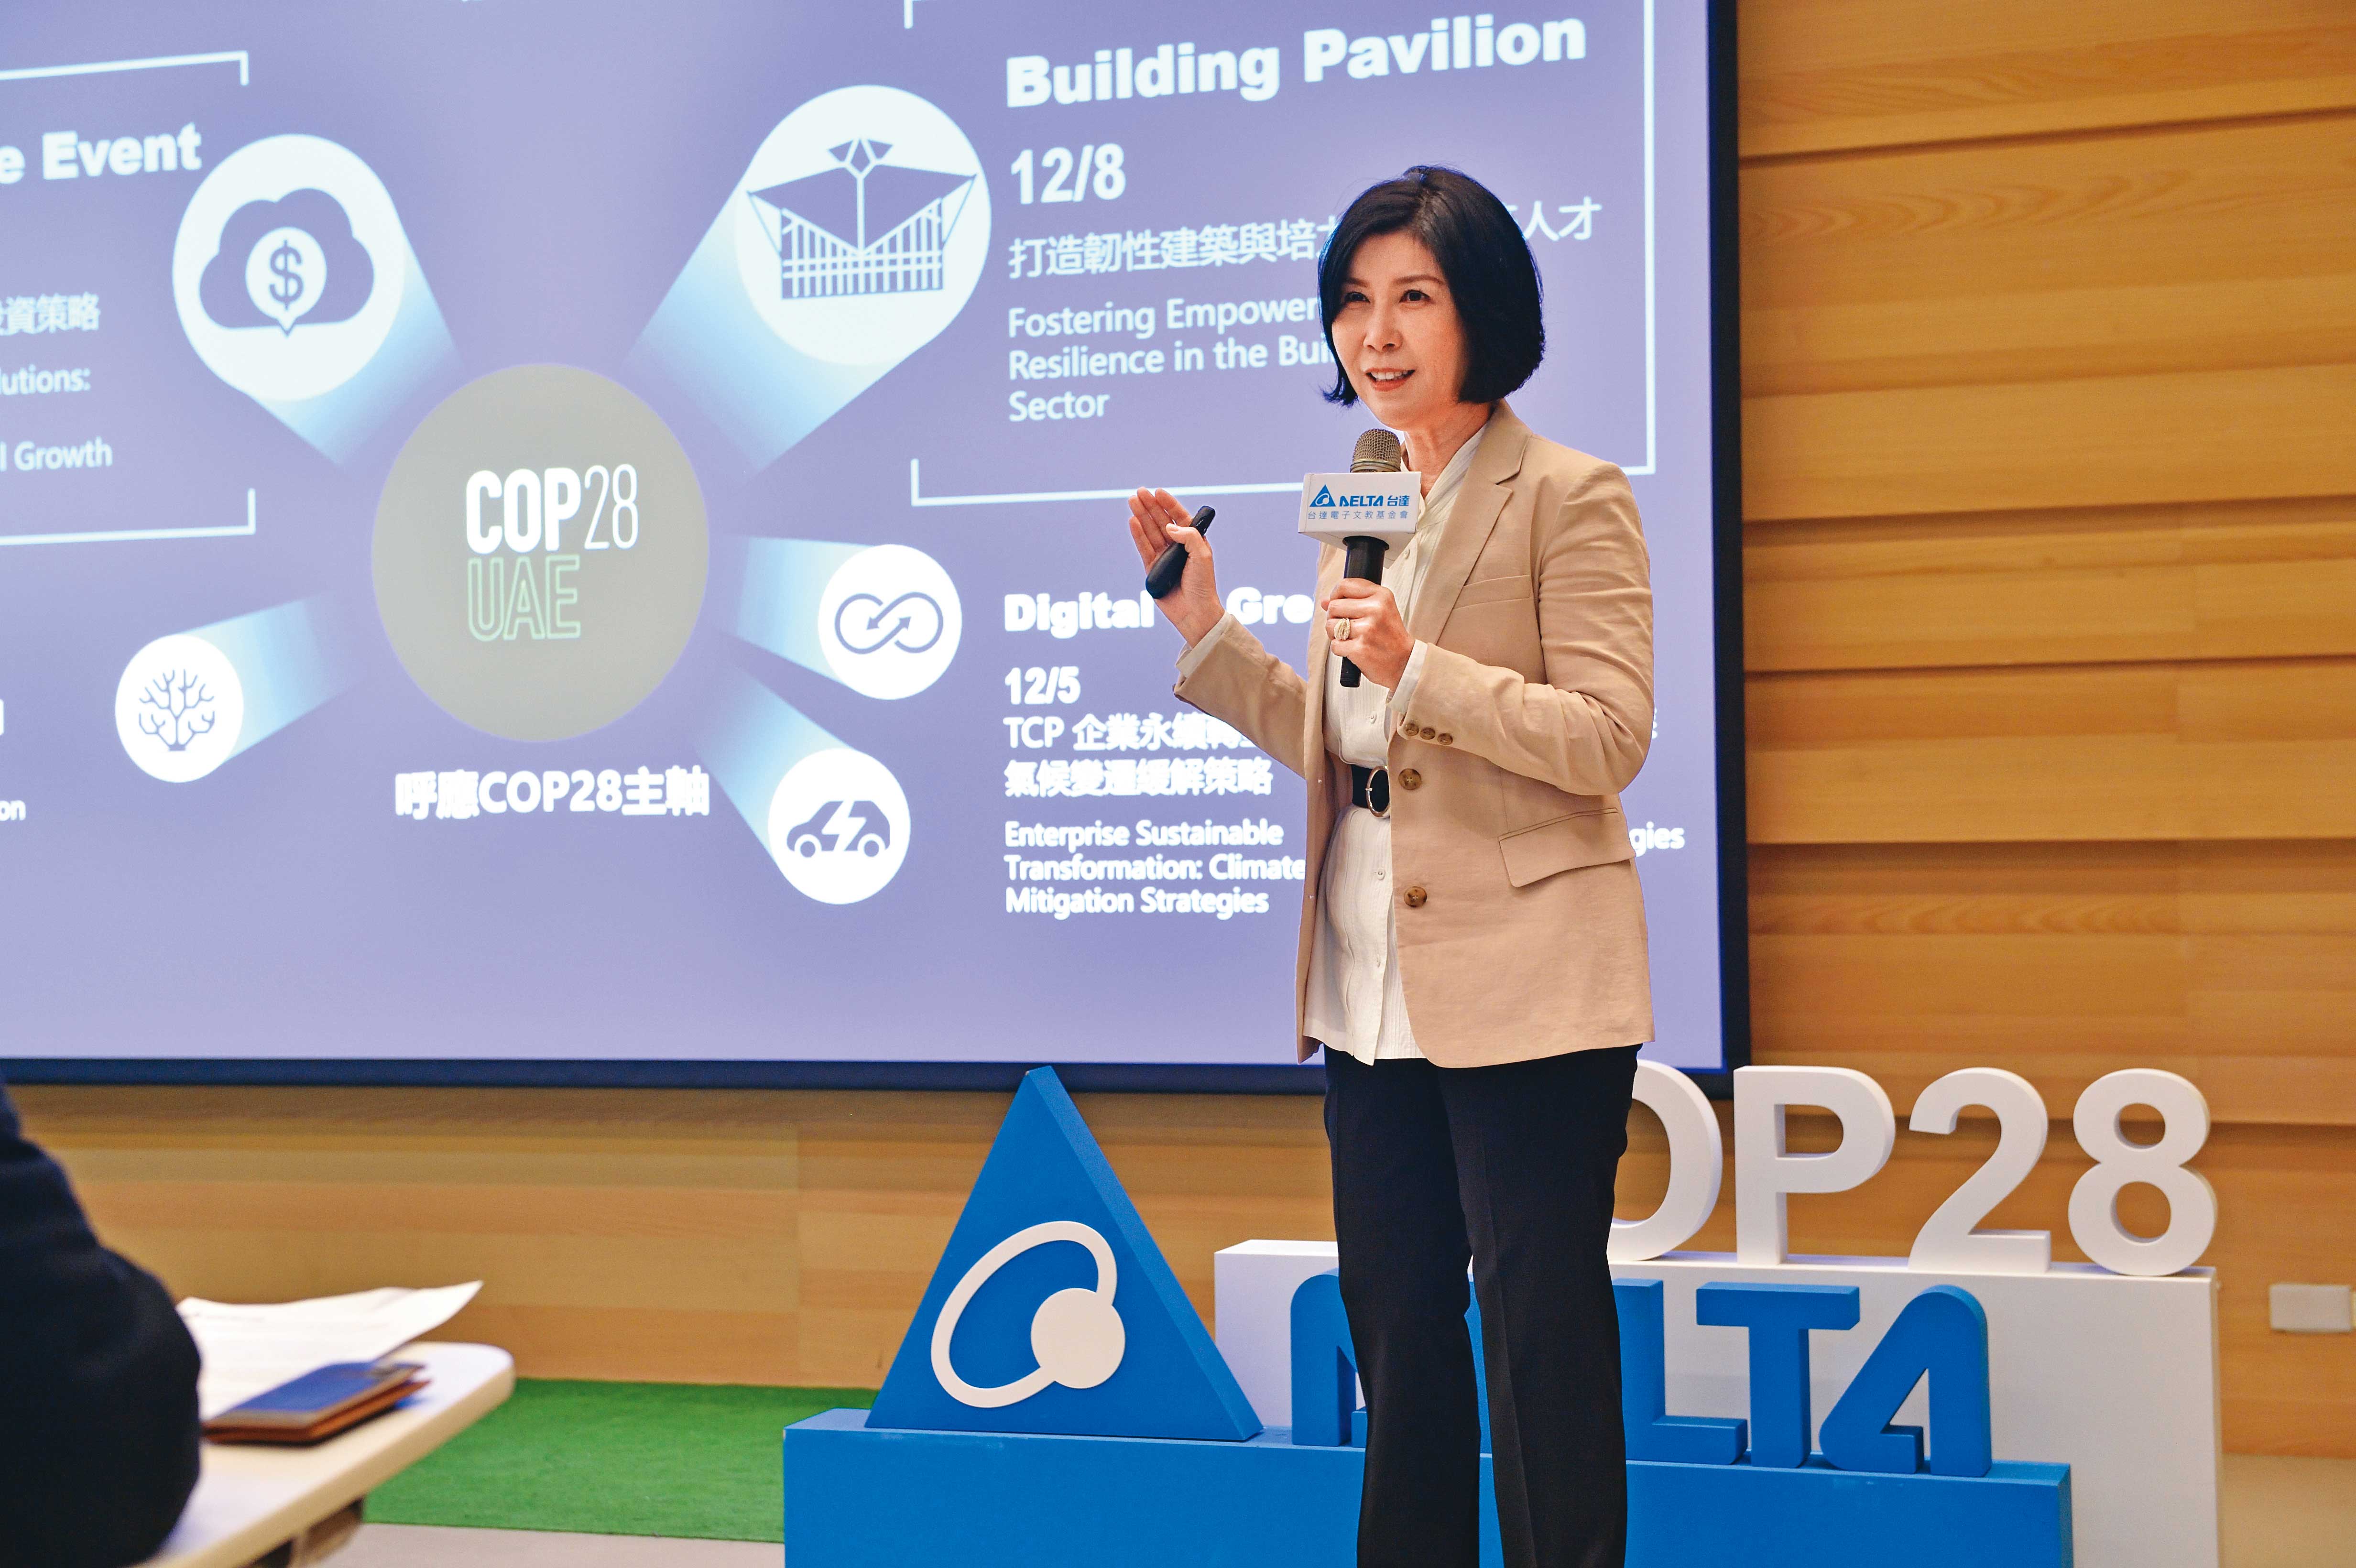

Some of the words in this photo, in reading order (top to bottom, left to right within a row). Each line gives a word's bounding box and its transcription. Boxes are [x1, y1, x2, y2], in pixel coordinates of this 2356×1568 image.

[1006, 42, 1280, 108] Building
[1304, 13, 1586, 82] Pavilion
[43, 122, 202, 180] Event
[1011, 143, 1126, 204] 12/8
[1504, 196, 1602, 241] 人才
[0, 292, 100, 336] 資策略
[1009, 302, 1155, 338] Fostering
[1009, 346, 1164, 380] Resilience
[1174, 341, 1204, 371] in
[1213, 337, 1268, 370] the
[1278, 333, 1336, 366] Bui
[0, 364, 91, 395] utions:
[1009, 391, 1110, 422] Sector
[14, 436, 113, 471] Growth
[466, 464, 639, 554] COP28
[1308, 510, 1408, 520] 台達電子文教基金會
[1339, 495, 1384, 507] DELTA
[1387, 495, 1410, 506] 台達
[468, 555, 581, 642] UAE
[1004, 589, 1155, 639] Digital
[1004, 666, 1081, 705] 12/5
[1003, 716, 1065, 748] TCP
[1072, 712, 1257, 751] 企業永續轉
[395, 764, 710, 820] 呼應COP28主軸
[1003, 756, 1274, 797] 氣候變遷緩解策略
[1004, 820, 1130, 853] Enterprise
[1135, 818, 1285, 846] Sustainable
[1003, 853, 1203, 881] Transformation:
[1209, 852, 1306, 880] Climate
[1006, 886, 1134, 920] Mitigation
[1140, 886, 1270, 920] Strategies
